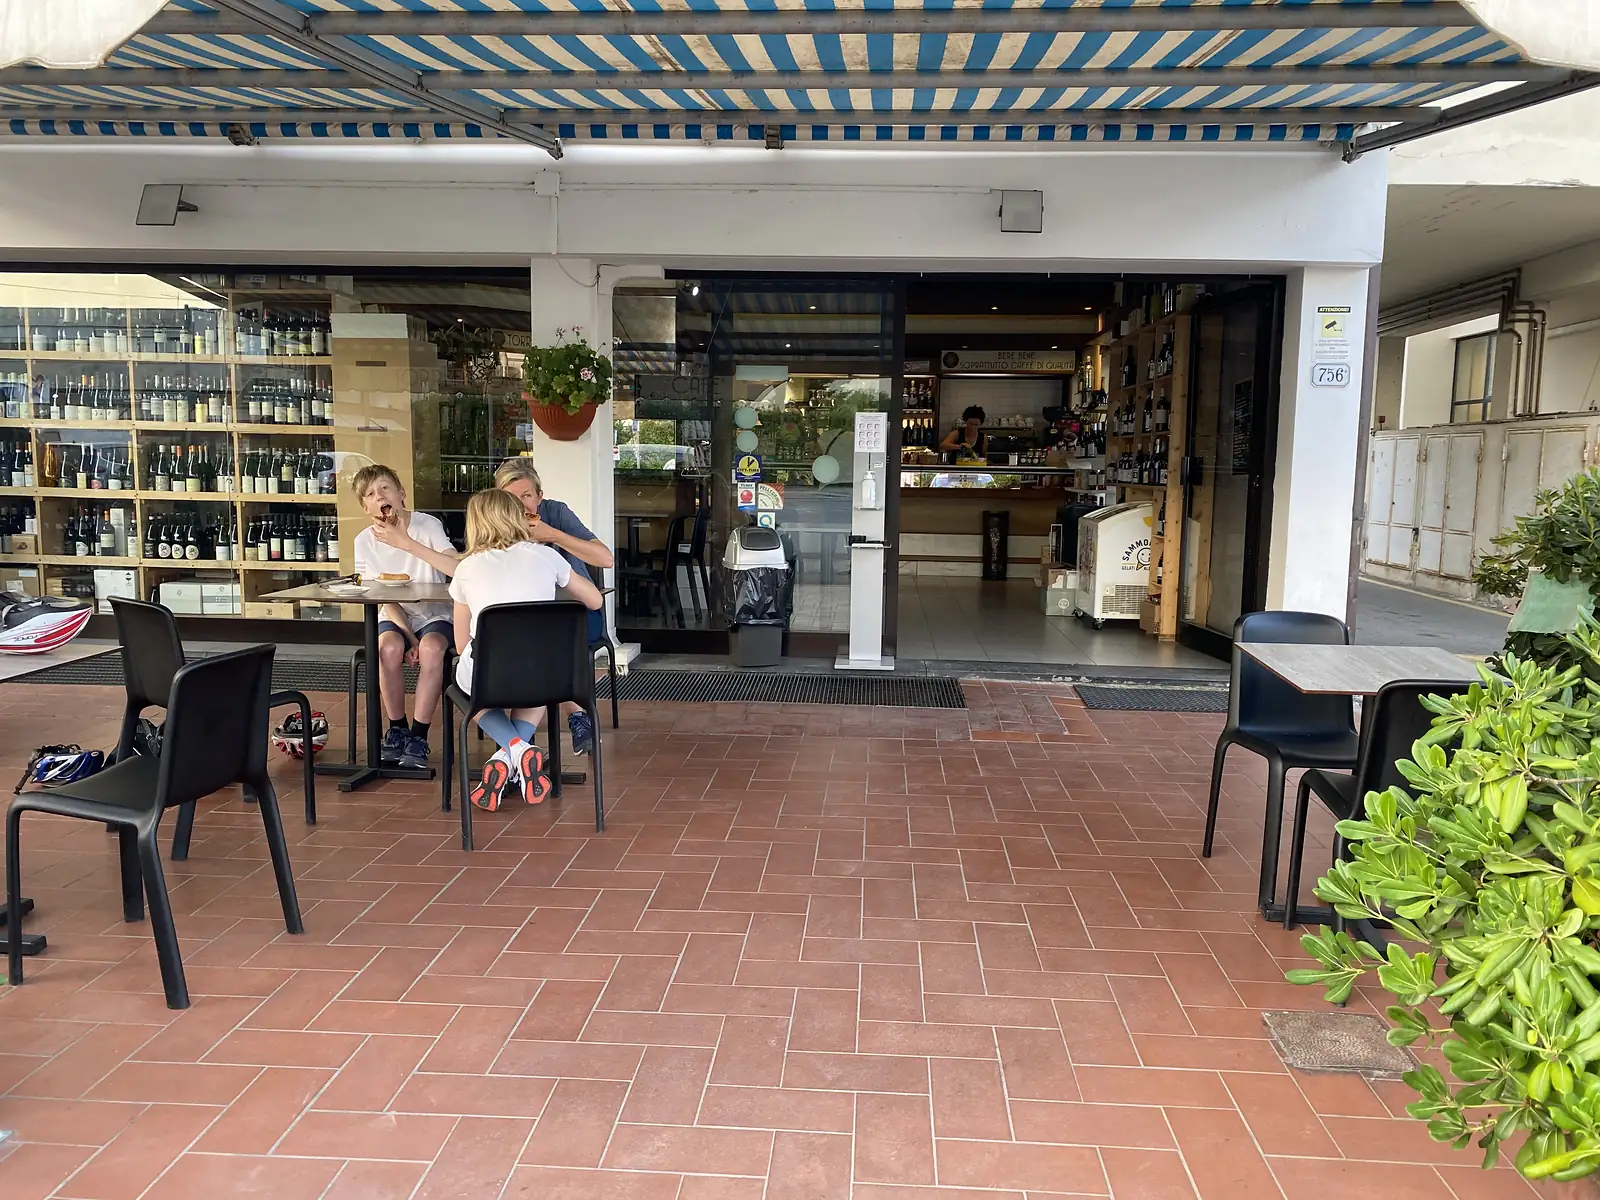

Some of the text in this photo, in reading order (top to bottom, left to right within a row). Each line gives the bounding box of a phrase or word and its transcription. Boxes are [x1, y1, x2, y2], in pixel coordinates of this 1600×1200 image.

[960, 361, 1008, 369] SOPRATTUTTO
[1037, 361, 1044, 369] DI
[1122, 539, 1151, 561] SAMMO
